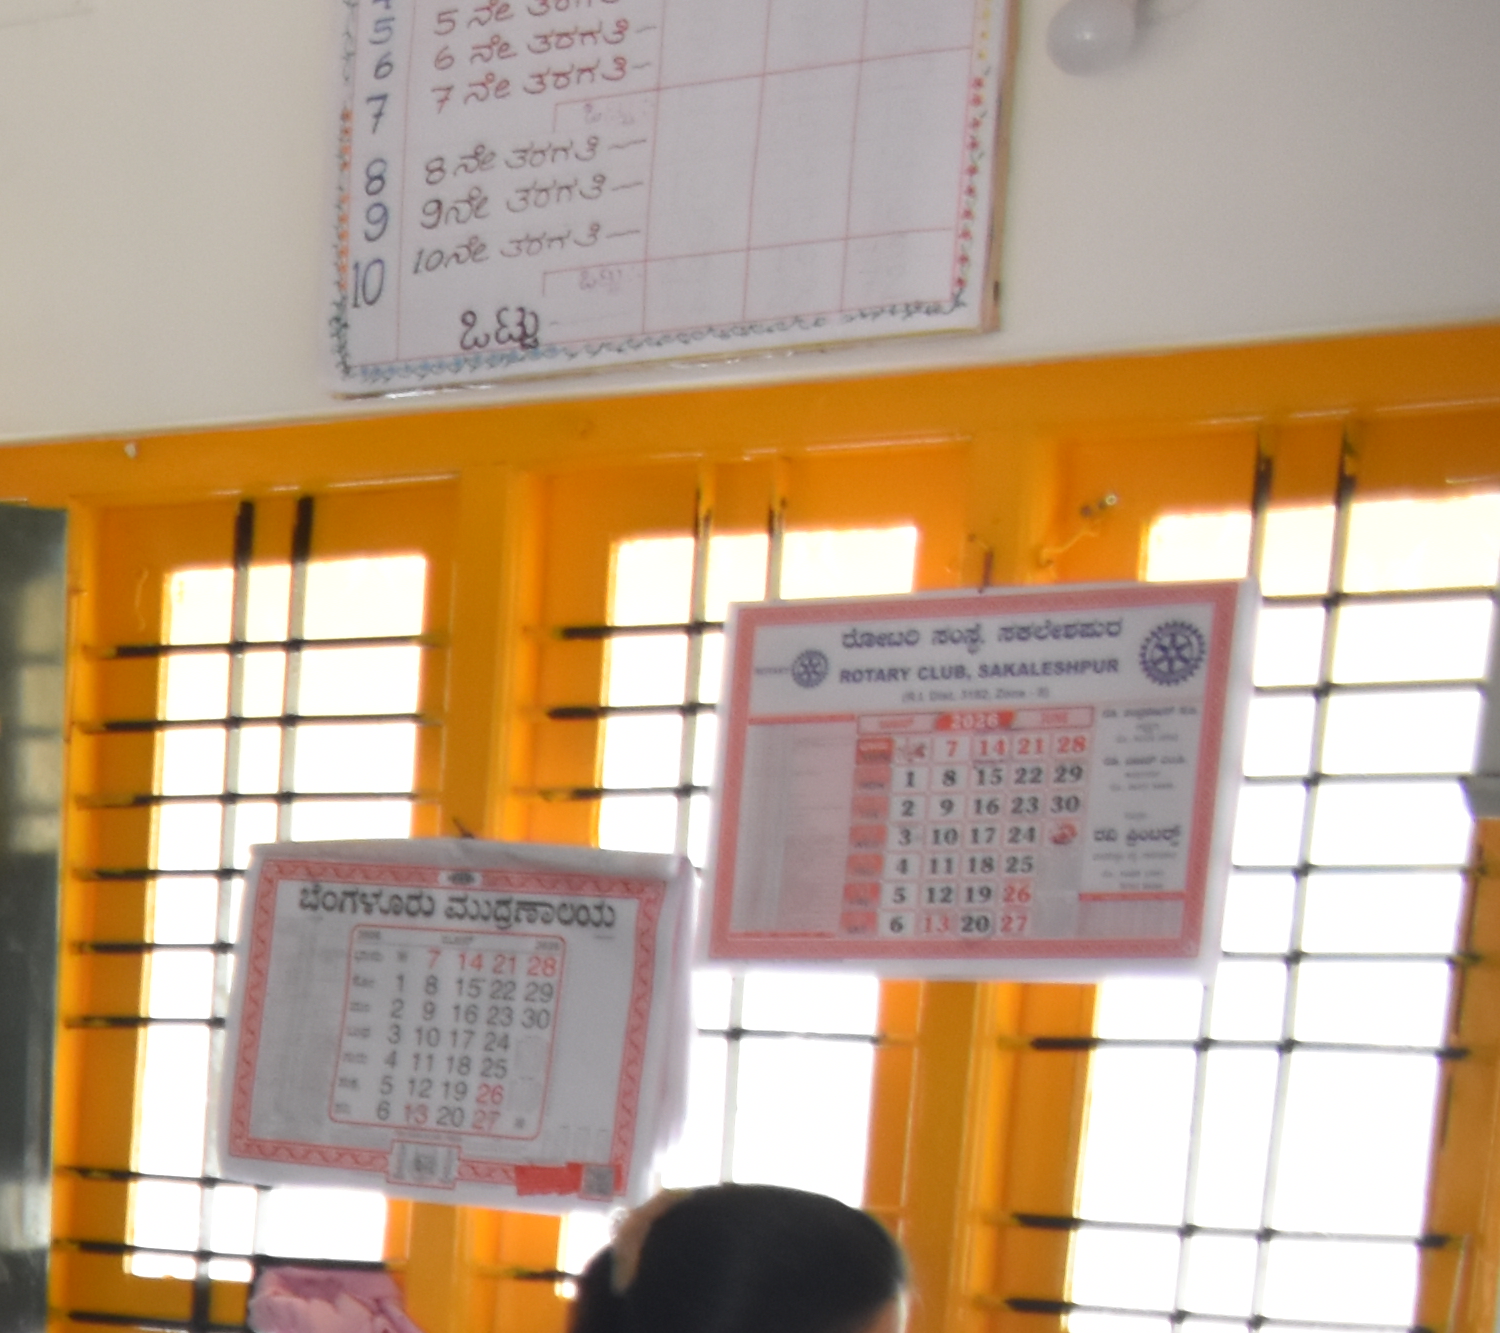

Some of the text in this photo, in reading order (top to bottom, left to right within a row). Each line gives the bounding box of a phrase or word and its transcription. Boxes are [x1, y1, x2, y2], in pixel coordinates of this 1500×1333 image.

[369, 17, 395, 45] 5
[434, 9, 458, 35] 5
[373, 52, 394, 79] 6
[434, 46, 454, 70] 6
[431, 85, 454, 114] 7
[366, 95, 389, 134] 7
[365, 158, 387, 196] 8
[364, 203, 389, 242] 9
[351, 259, 385, 309] 10
[839, 658, 1120, 684] ROTARY CLUB, SAKALESHPUR
[951, 713, 999, 729] 2026
[946, 736, 1087, 757] 7 14 21 28
[905, 771, 915, 788] 1
[942, 769, 957, 786] 8
[977, 768, 1003, 786] 15
[1014, 766, 1043, 784] 22
[1053, 765, 1083, 783] 29
[901, 796, 1080, 817] 2 9 16 23 30
[899, 826, 1036, 846] 3 10 17 24
[896, 855, 1034, 875] 4 11 18 25
[298, 884, 616, 929] ಬೆಂಗಳೂರು ಮುದ್ರಣಾಲಯ
[893, 885, 1031, 904] 5 12 19 26
[890, 915, 1028, 933] 6 13 20 27
[429, 947, 556, 977] 7 14 21 28
[397, 974, 553, 1003] 1 8 15 22 29
[391, 999, 550, 1030] 2 9 16 23 30
[387, 1024, 509, 1052] 3 10 17 24
[384, 1050, 507, 1079] 4 11 18 25
[380, 1075, 504, 1105] 5 12 19 26
[376, 1100, 501, 1131] 6 13 20 27
